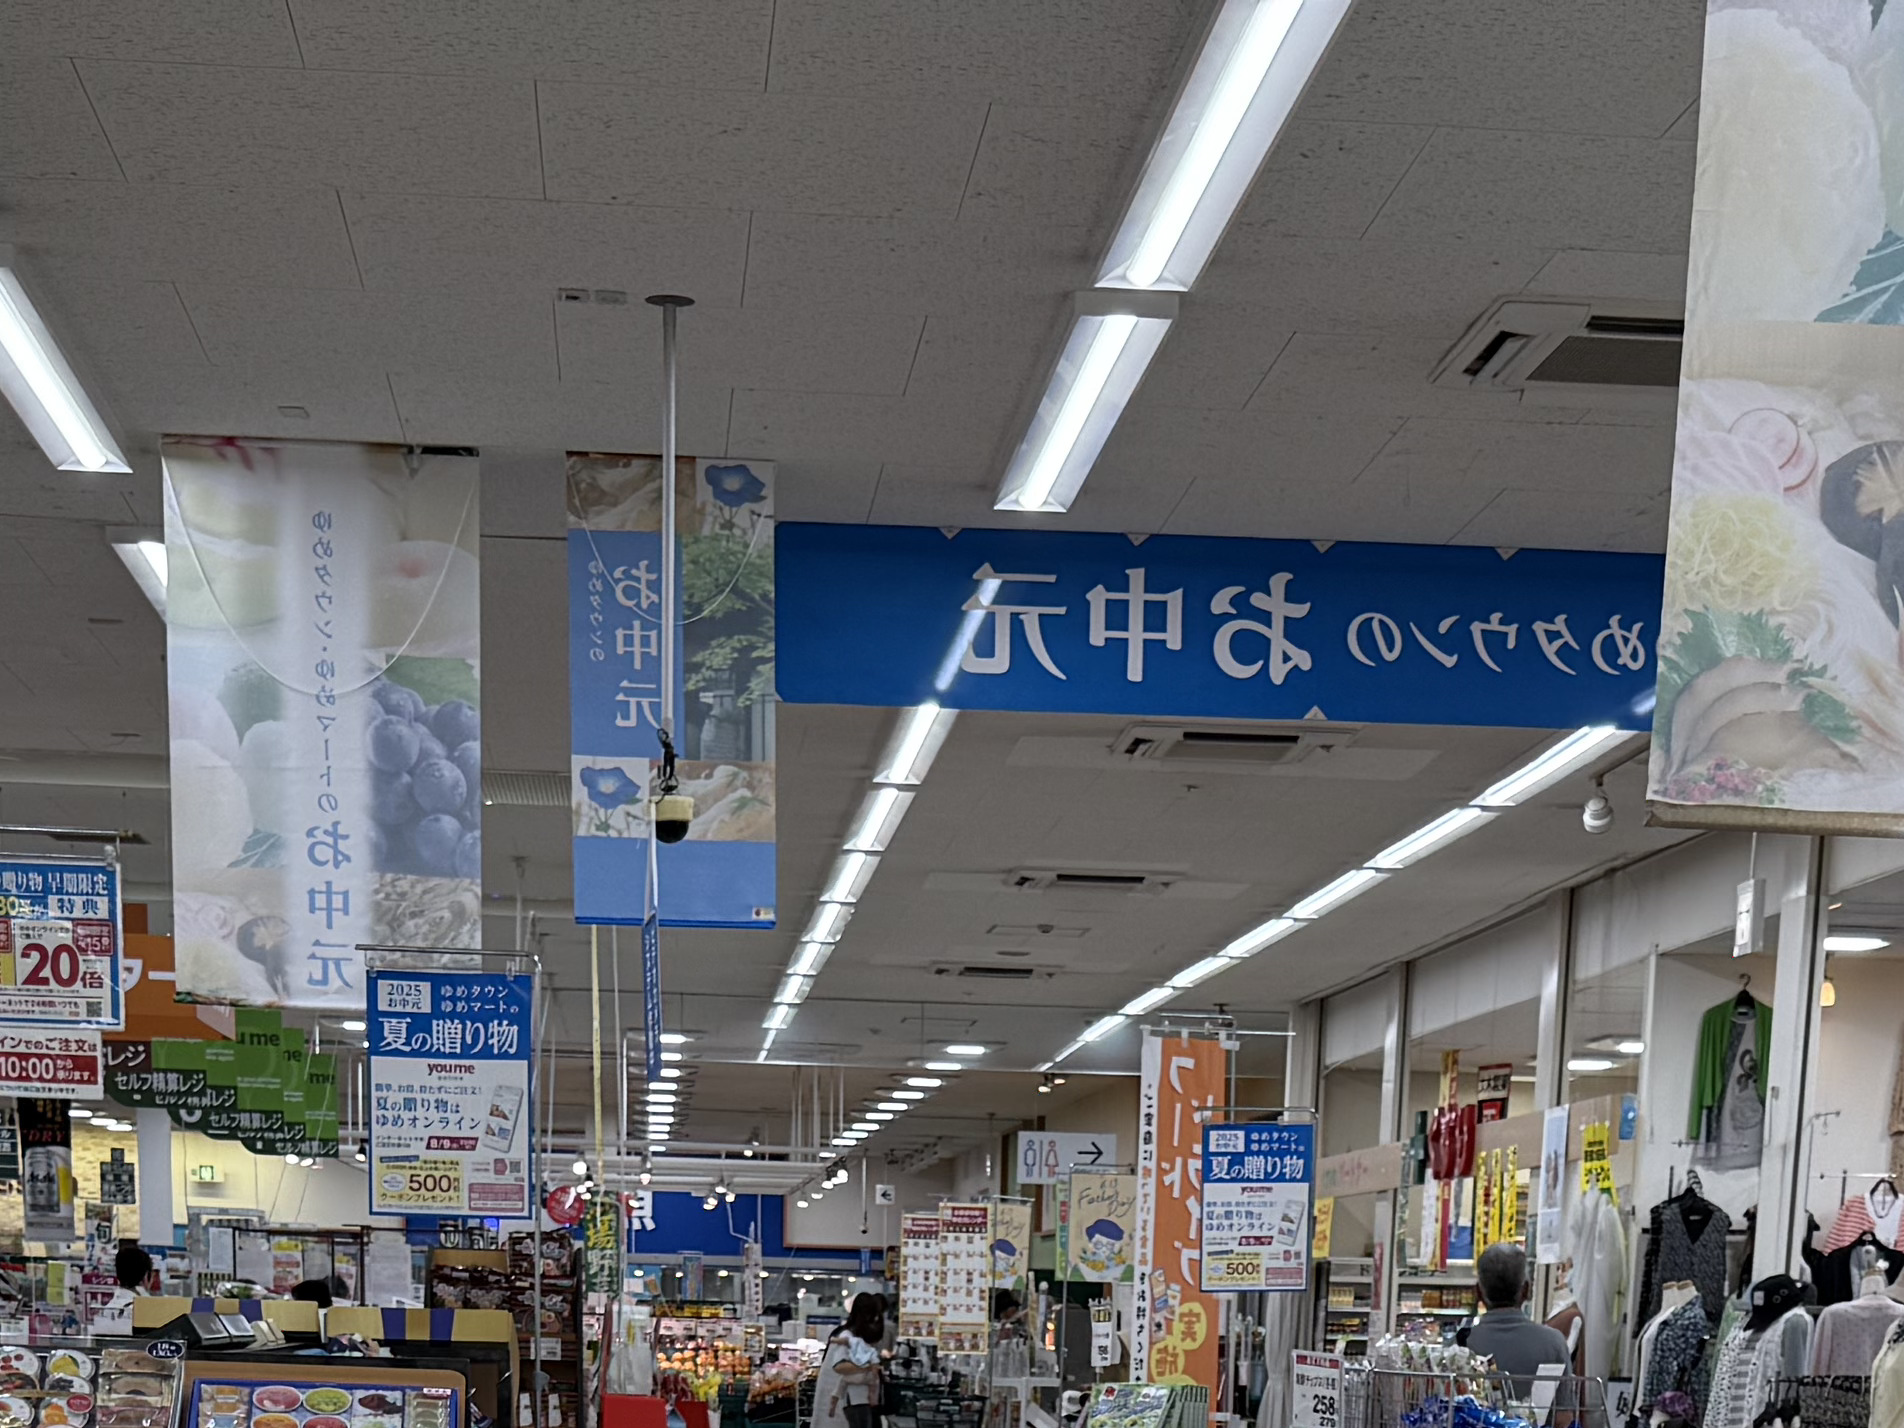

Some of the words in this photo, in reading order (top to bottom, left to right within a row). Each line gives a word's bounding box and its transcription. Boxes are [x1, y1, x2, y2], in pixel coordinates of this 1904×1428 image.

[48, 873, 108, 895] 早期限定
[58, 896, 101, 915] 特典
[387, 983, 422, 998] 2025
[440, 985, 509, 998] ゆめタウン
[388, 998, 422, 1010] お中元
[440, 1000, 520, 1014] ゆめマートの
[379, 1017, 519, 1055] 夏の贈り物
[115, 1072, 205, 1093] セルフ精算レジ
[376, 1097, 460, 1114] 夏の贈り物は
[376, 1114, 482, 1131] ゆめオンライン
[1209, 1155, 1304, 1180] 夏の贈り物
